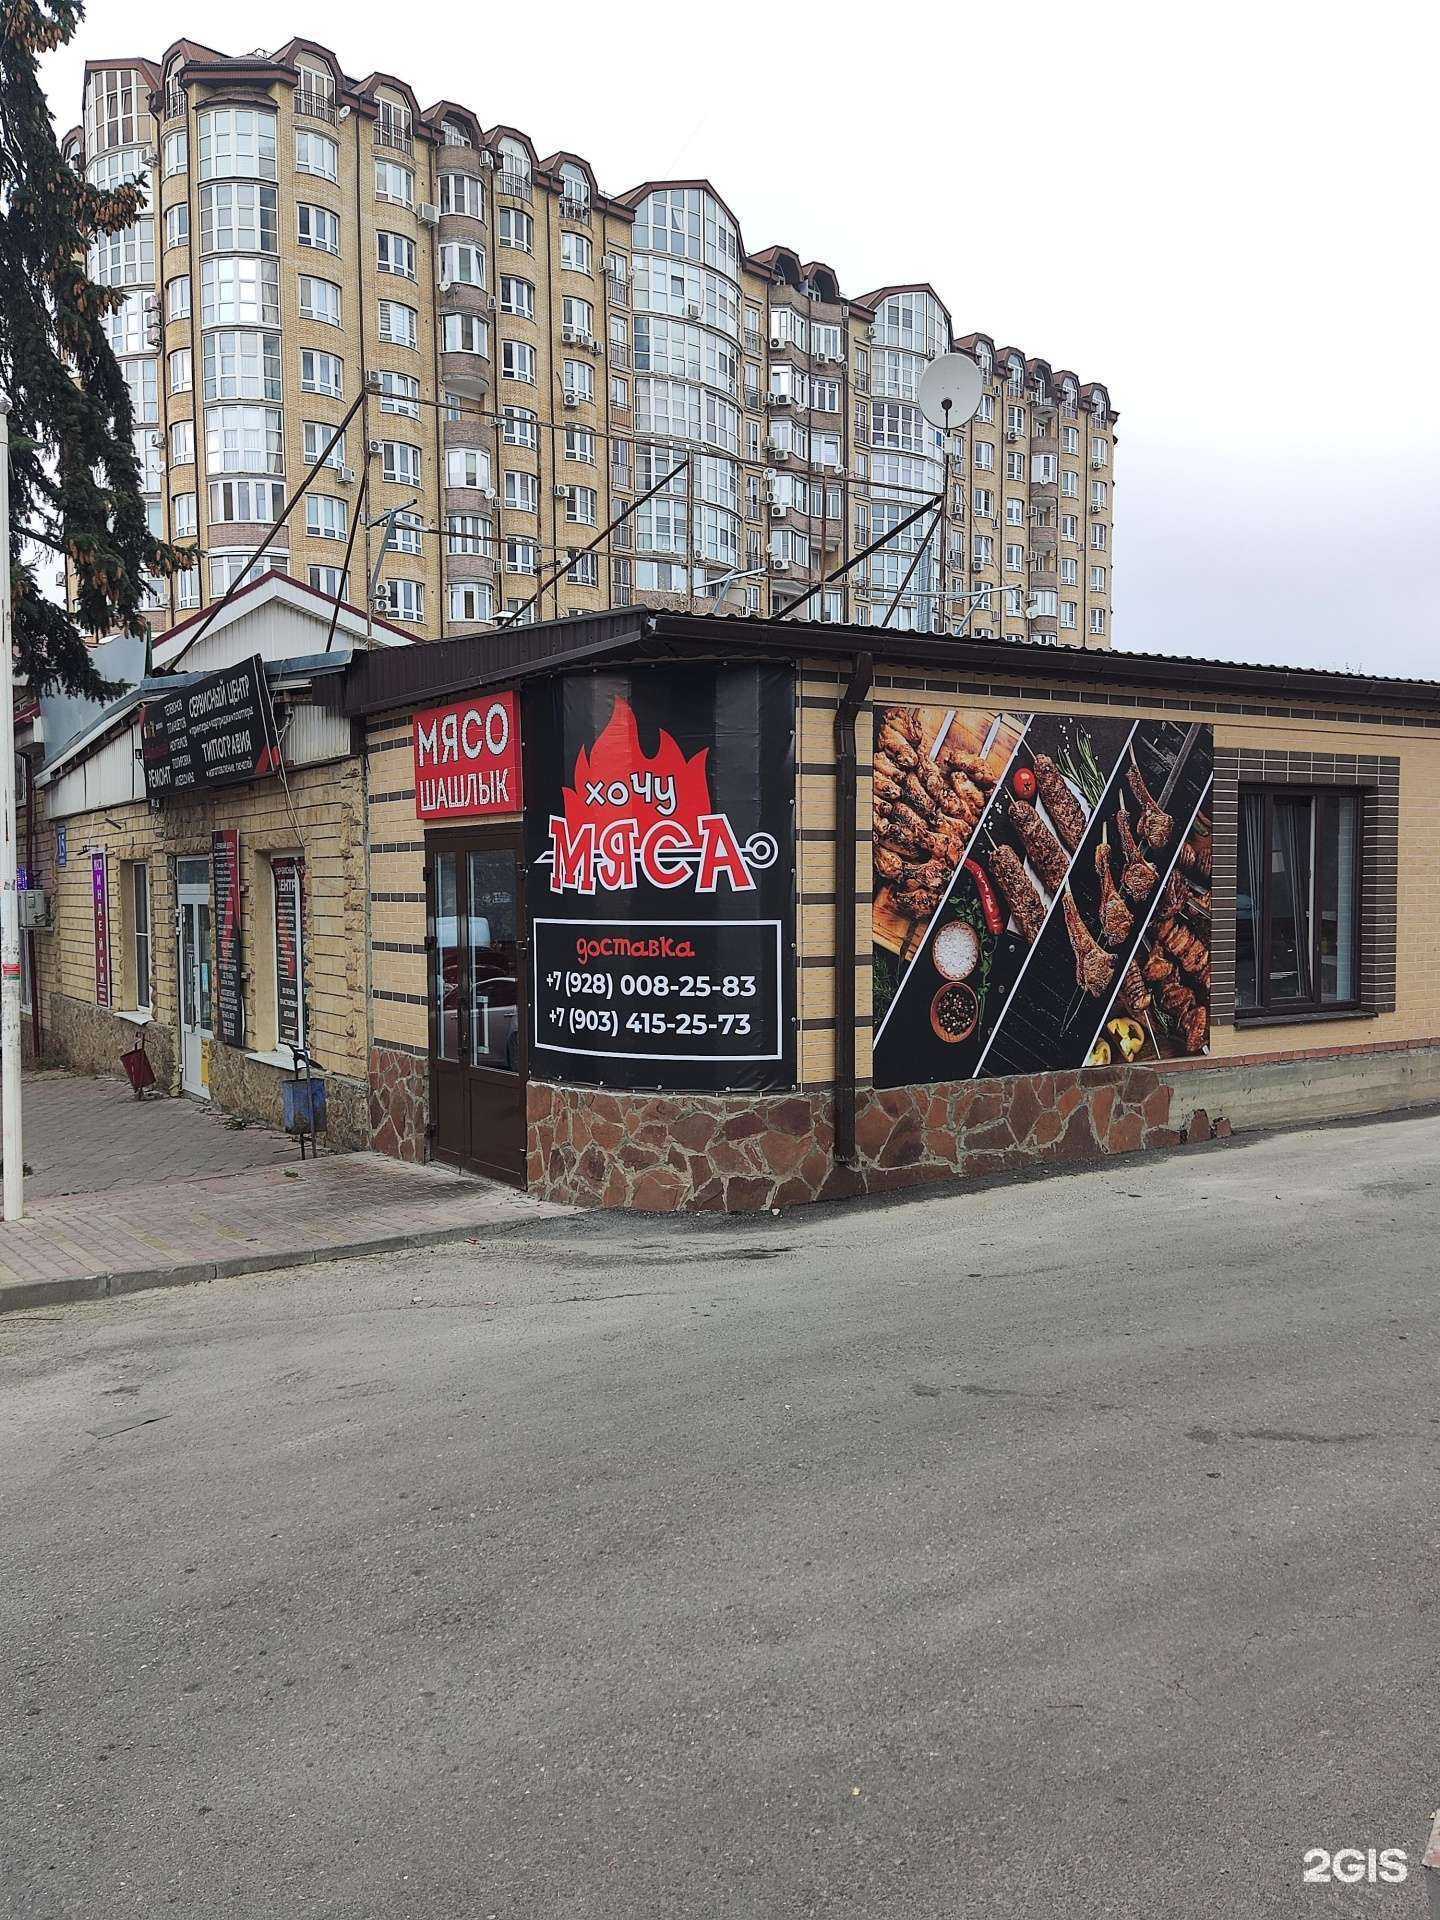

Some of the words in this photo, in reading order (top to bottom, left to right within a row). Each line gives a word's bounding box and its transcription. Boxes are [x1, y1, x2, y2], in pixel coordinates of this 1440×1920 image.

[188, 679, 227, 718] СЕРВИСНЫЙ
[226, 674, 250, 705] ЦЕНТР
[201, 729, 252, 763] ТИПОГРАФИЯ
[417, 702, 509, 767] МЯСО
[148, 765, 171, 788] РЕМОНТ
[420, 768, 509, 811] ШАШЛЫК
[548, 813, 758, 895] МЯСА
[576, 936, 696, 965] доставка
[546, 971, 562, 991] +7
[565, 971, 613, 1000] (928)
[620, 974, 757, 997] 008-25-83
[549, 1007, 565, 1027] +7
[569, 1007, 619, 1036] (903)
[625, 1012, 751, 1035] 415-25-73
